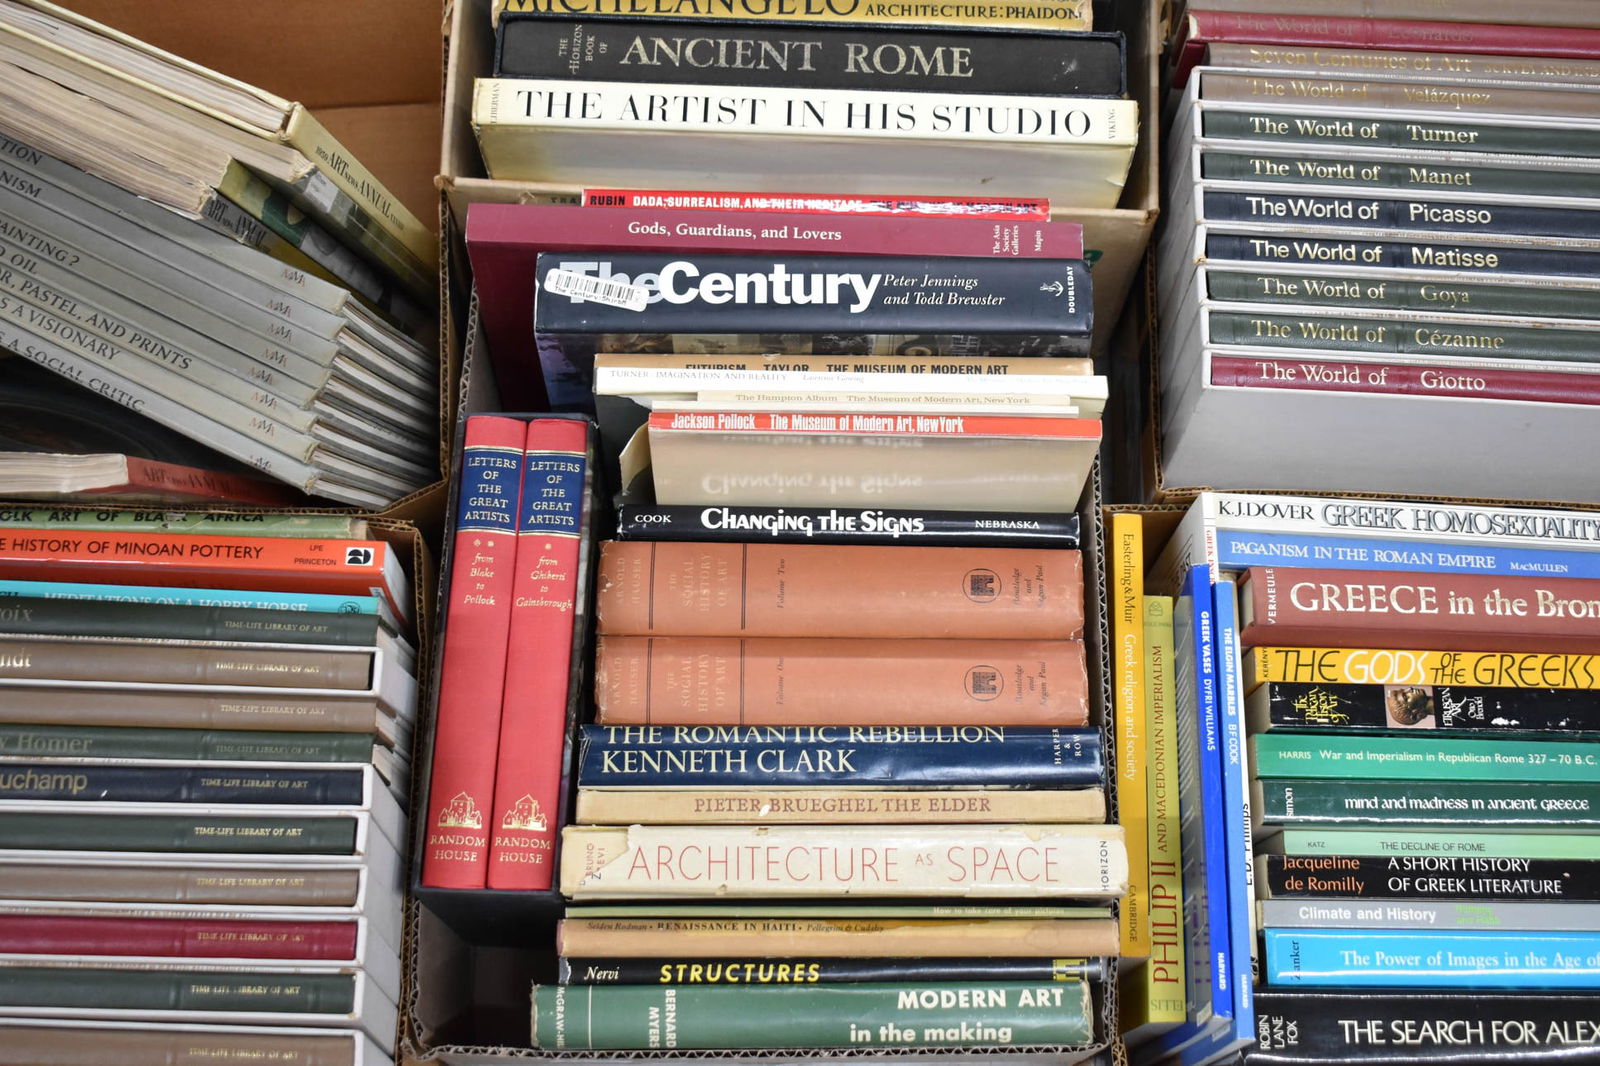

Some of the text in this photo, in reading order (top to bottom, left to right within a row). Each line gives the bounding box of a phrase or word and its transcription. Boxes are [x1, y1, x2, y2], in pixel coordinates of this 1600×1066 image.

[620, 35, 974, 77] ANCIENT ROME
[517, 90, 1091, 137] THE ARTIST IN HIS STUDIO
[1108, 108, 1116, 139] VIKING
[590, 195, 625, 206] RUBIN
[1246, 197, 1492, 224] The World of Picasso
[628, 222, 842, 240] Gods, Guardians, and Lovers
[658, 261, 882, 313] Century
[883, 274, 979, 288] Peter Jennings
[883, 292, 1006, 306] and Todd Brewster
[30, 309, 120, 361] VISIONARY
[85, 316, 193, 370] AND PRINTS
[1256, 362, 1486, 391] The World of Giotto
[671, 414, 964, 433] Jackson Pollock The Museum of Modern Art, New York
[468, 457, 516, 469] LETTERS
[483, 471, 499, 479] OF
[477, 484, 502, 494] THE
[469, 498, 508, 509] GREAT
[465, 511, 510, 523] ARTISTS
[975, 520, 1040, 529] NEBRASKA
[1322, 504, 1406, 529] GREEK
[12, 538, 264, 560] HISTORY OF MINOAN POTTERY
[1231, 541, 1496, 568] PAGANISM IN THE ROMAN EMPIRE
[294, 558, 337, 566] PRINCETON
[1266, 568, 1277, 625] VERMEULE
[1290, 582, 1528, 616] GREECE in the
[1275, 650, 1595, 688] THE GODS OF THE GREEKS
[1122, 634, 1139, 781] Greek religion and society
[603, 726, 1005, 744] THE ROMANTIC REBELLION
[1206, 706, 1215, 751] WILLIAMS
[17, 733, 93, 753] Homer
[1152, 645, 1168, 852] AND MACEDONIAN IMPERIALISM
[602, 749, 856, 773] KENNETH CLARK
[1279, 750, 1525, 764] HARRIS War and Imperialism in Republican Rome
[694, 798, 991, 813] PIETER BRUEGHEL THE ELDER
[195, 827, 303, 837] TIME-LIFE LIBRARY OF ART
[430, 835, 485, 847] RANDOM
[495, 836, 551, 849] RANDOM
[1380, 842, 1486, 851] THE DECLINE OF ROME
[434, 850, 477, 862] HOUSE
[500, 852, 543, 864] HOUSE
[628, 845, 1058, 882] ARCHITECTURE AS SPACE
[1100, 841, 1109, 891] HORIZON
[1283, 856, 1360, 872] Jacqueline
[1388, 856, 1530, 872] A SHORT HISTORY
[1285, 877, 1365, 894] de Romilly
[1388, 877, 1563, 894] OF GREEK LITERATURE
[1128, 885, 1138, 942] CAMBRIDGE
[1151, 861, 1179, 984] PHILIP II
[1299, 907, 1436, 924] Climate and History
[657, 922, 796, 931] RENAISSANCE IN HAITI
[1341, 950, 1581, 969] The Power of Images in the Age
[584, 966, 620, 981] Nervi
[660, 964, 820, 983] STRUCTURES
[1218, 952, 1227, 990] HARVARD
[897, 989, 1064, 1010] MODERN ART
[649, 1007, 660, 1047] MYERS
[665, 989, 676, 1047] BERNARD
[850, 1022, 1012, 1043] in the making
[1258, 1015, 1271, 1050] ROBIN
[1272, 1016, 1285, 1048] LANE
[1287, 1020, 1298, 1044] FOX
[1338, 1020, 1386, 1044] THE
[1391, 1020, 1484, 1044] SEARCH
[1491, 1020, 1539, 1044] FOR
